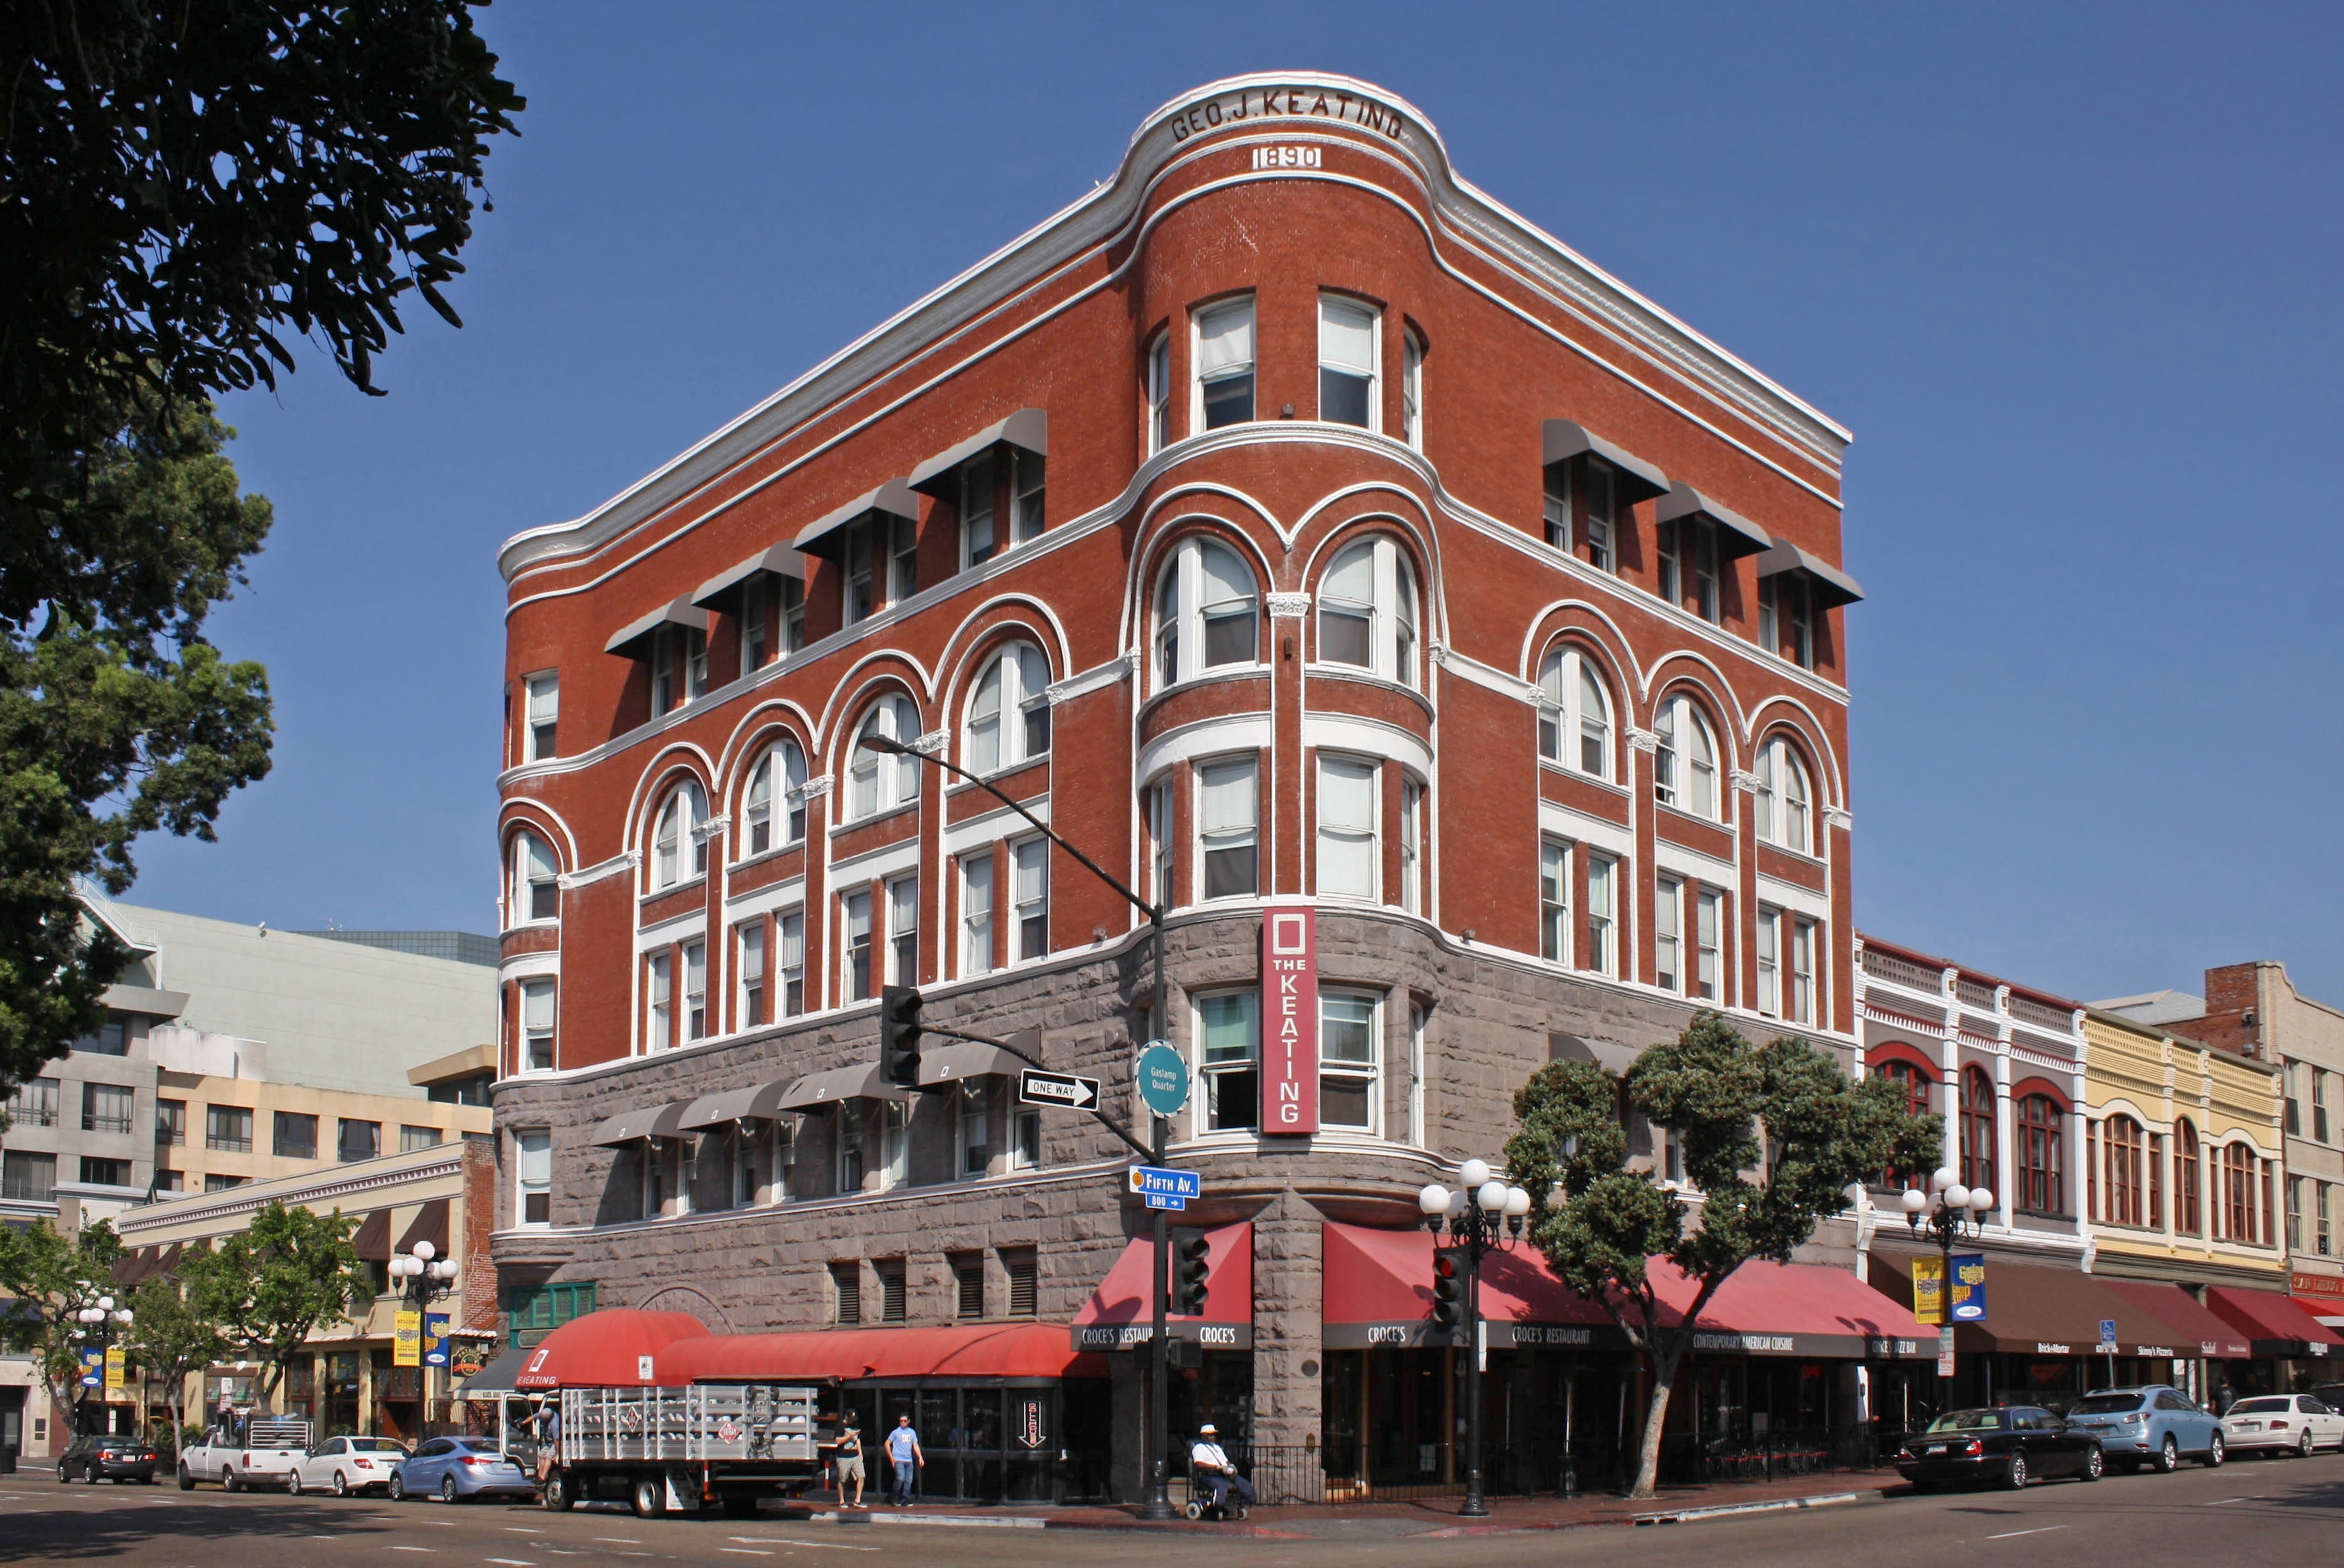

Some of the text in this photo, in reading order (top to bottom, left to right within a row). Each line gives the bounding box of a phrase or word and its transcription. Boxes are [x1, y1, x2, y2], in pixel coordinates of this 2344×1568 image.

[1252, 146, 1323, 170] 1890
[1272, 959, 1306, 971] THE
[1280, 974, 1300, 1124] KEATING
[1151, 1067, 1177, 1081] Gaslamp
[1034, 1082, 1074, 1096] ONE WAY
[1152, 1079, 1175, 1091] Quarter
[1146, 1173, 1174, 1191] FIFTH
[1152, 1195, 1166, 1206] 800
[1082, 1327, 1170, 1344] CROCE'S RESTAURT
[1200, 1327, 1236, 1343] CROCE'S
[1368, 1327, 1405, 1343] CROCE'S
[1512, 1326, 1590, 1345] CROCE'S RESTAURANT
[1693, 1334, 1793, 1351] CONTEMPORARY AMERICAN CUISINE
[1906, 1341, 1917, 1353] BAR
[523, 1375, 557, 1385] KEATING
